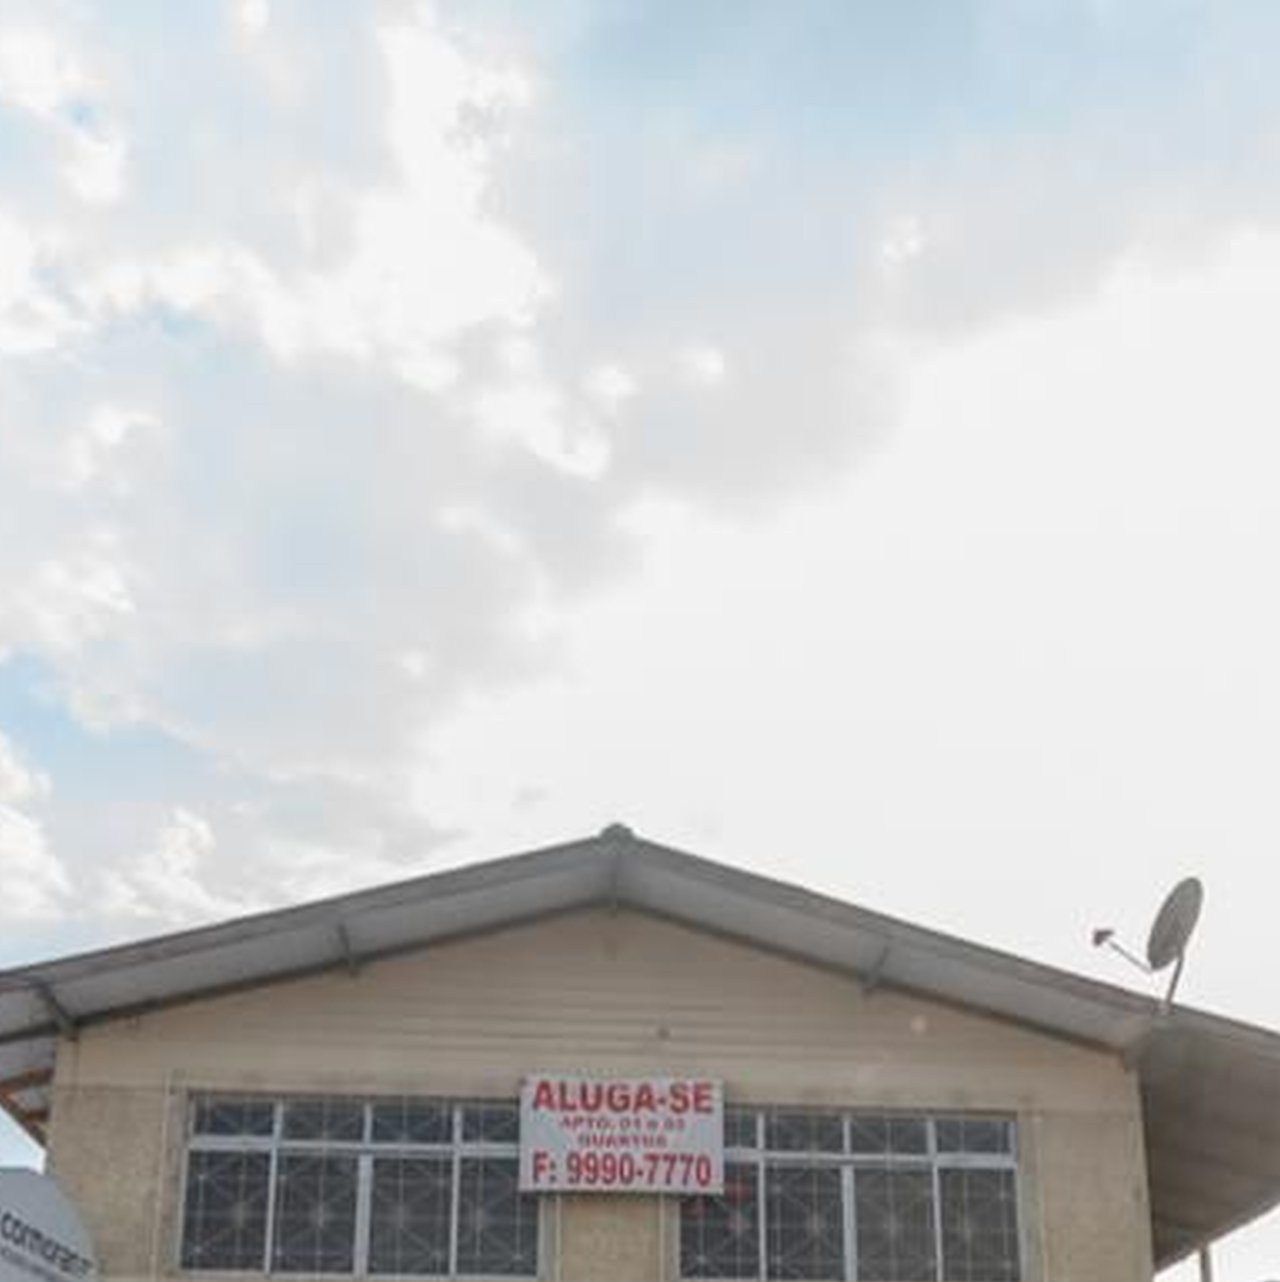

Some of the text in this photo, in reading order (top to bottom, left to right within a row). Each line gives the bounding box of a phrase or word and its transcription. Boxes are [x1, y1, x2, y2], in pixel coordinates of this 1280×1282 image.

[532, 1081, 713, 1114] ALUGA-SE
[533, 1151, 712, 1187] F: 9990-7770
